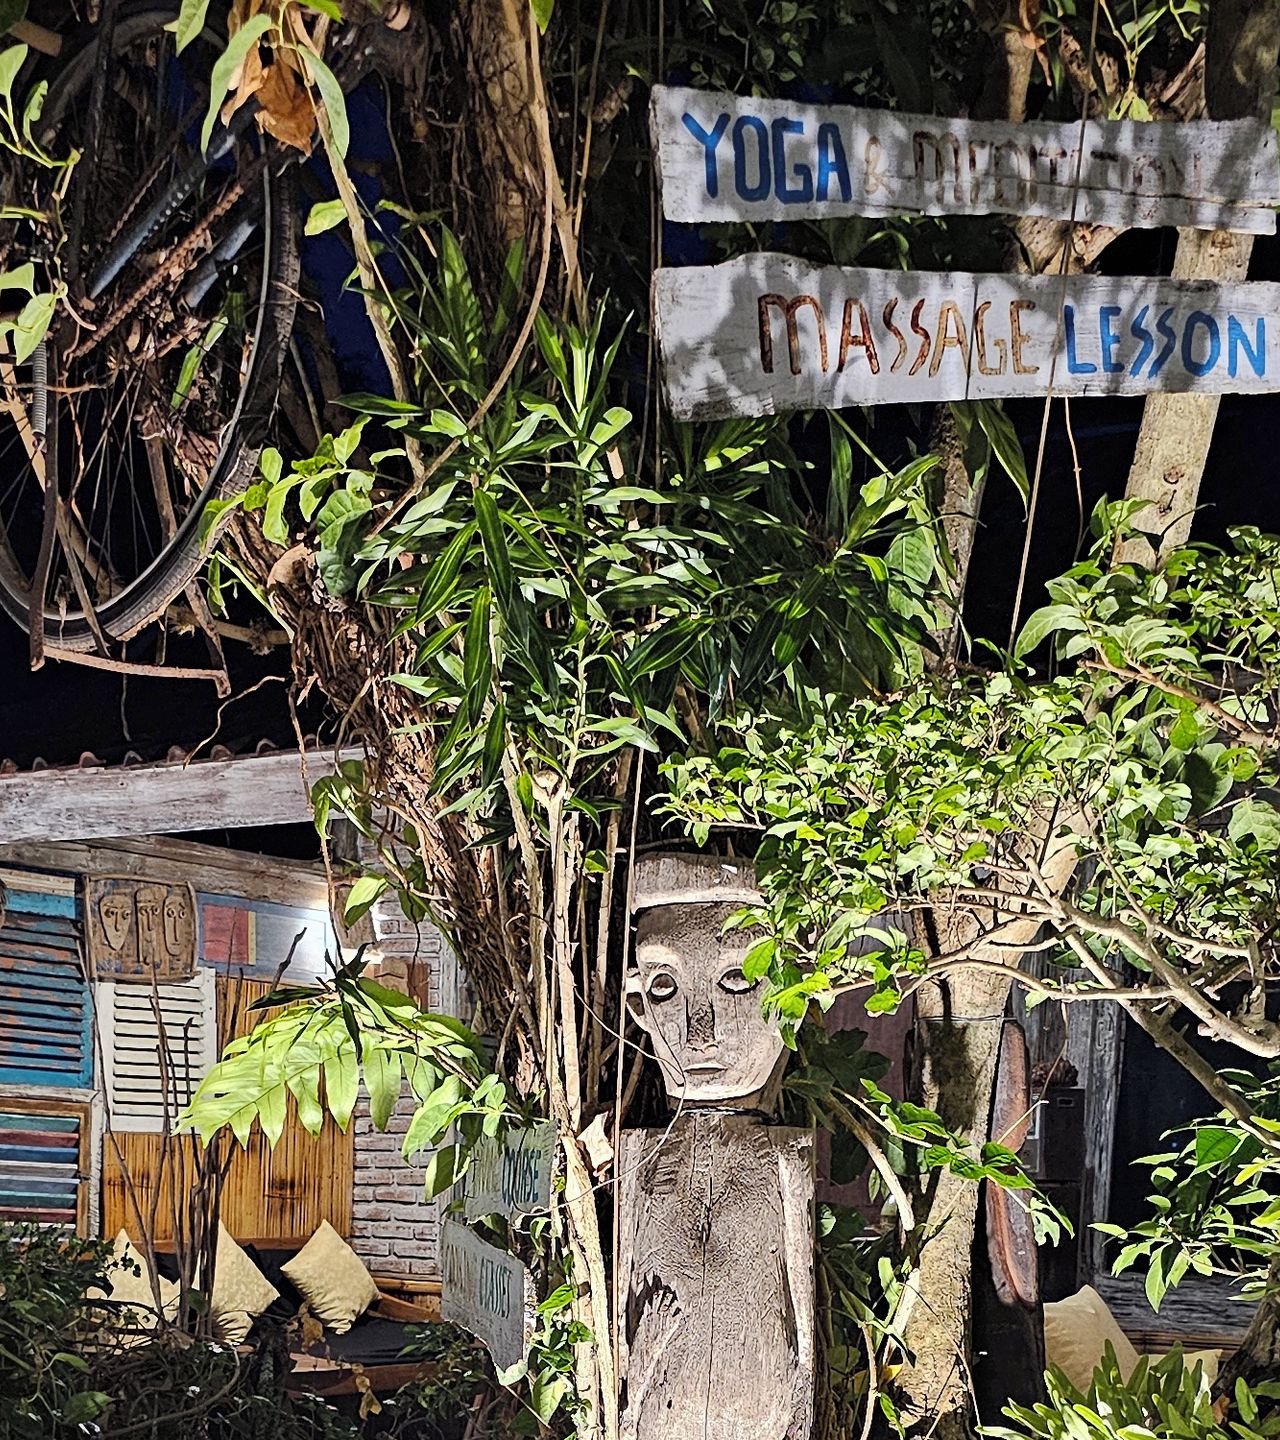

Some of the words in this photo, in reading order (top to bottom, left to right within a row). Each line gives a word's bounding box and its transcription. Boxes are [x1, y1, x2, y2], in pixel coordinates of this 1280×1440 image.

[681, 111, 853, 203] YOGA
[863, 136, 897, 197] &
[757, 293, 1040, 378] MASSAGE
[1063, 304, 1266, 379] LESSON
